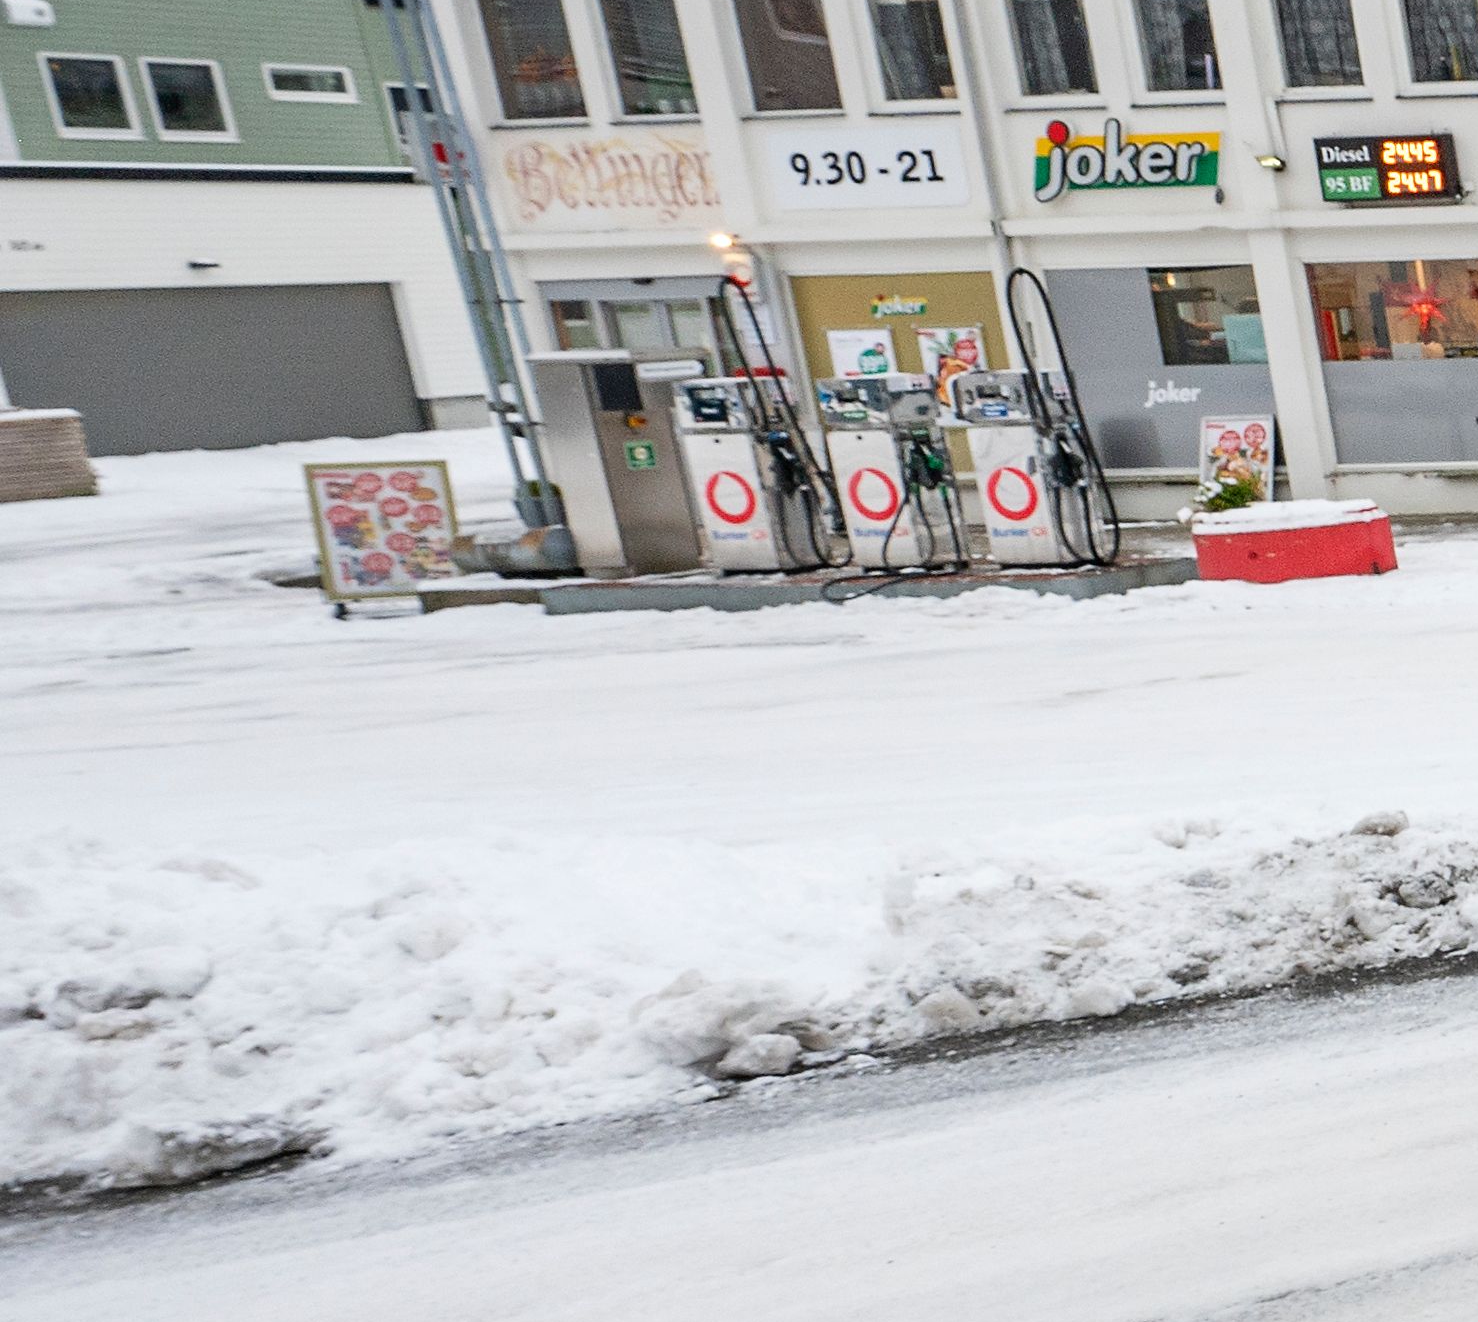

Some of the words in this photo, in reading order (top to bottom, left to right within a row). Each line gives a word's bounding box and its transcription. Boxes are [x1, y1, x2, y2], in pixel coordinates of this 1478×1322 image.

[790, 150, 866, 186] 9.30
[896, 149, 945, 182] 21
[1034, 117, 1206, 203] joker
[1320, 145, 1371, 164] Diesel
[1325, 176, 1346, 193] 95
[1349, 175, 1373, 192] BF
[1143, 380, 1202, 408] joker
